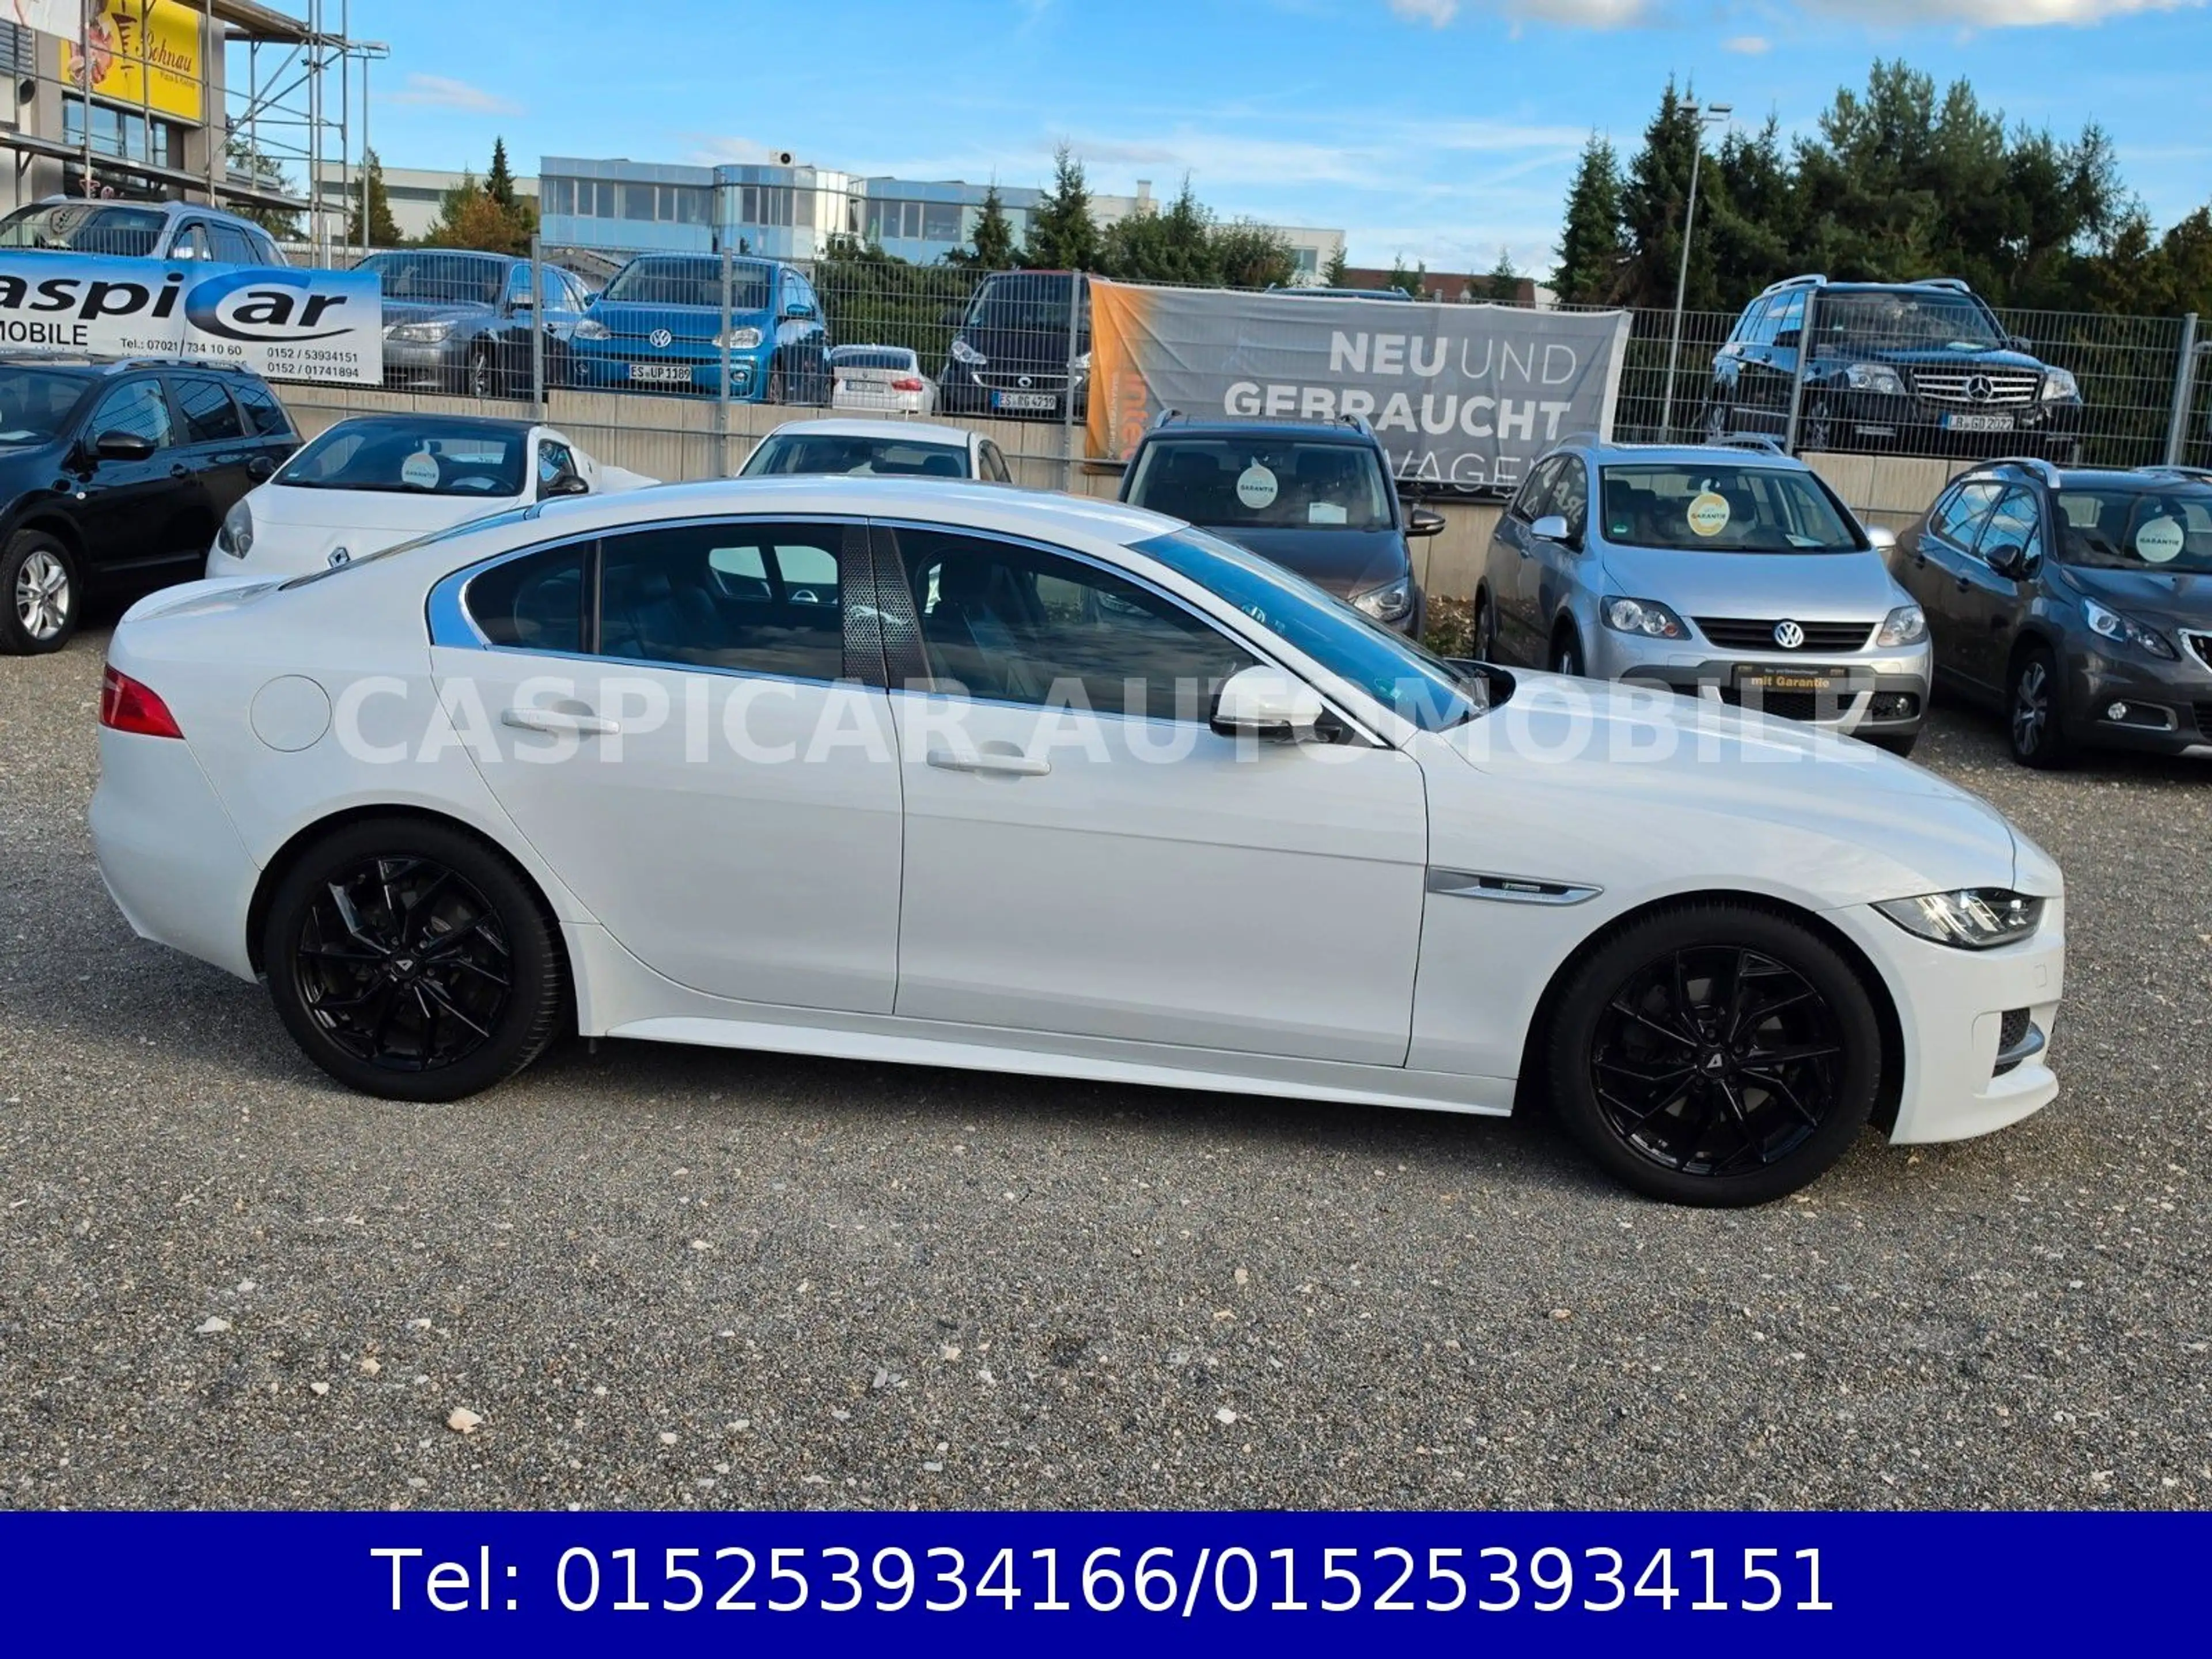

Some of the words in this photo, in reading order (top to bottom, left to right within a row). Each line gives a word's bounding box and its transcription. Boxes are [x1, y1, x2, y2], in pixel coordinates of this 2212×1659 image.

[0, 321, 88, 346] OBILE
[120, 338, 143, 349] Tel.:
[147, 340, 177, 351] 07021
[187, 342, 205, 353] 734
[212, 344, 224, 354] 10
[228, 346, 242, 355] 60
[267, 347, 294, 358] 0152
[305, 350, 358, 363] 53934151
[1330, 331, 1448, 377] NEU
[1461, 337, 1576, 385] UND
[268, 362, 294, 373] 0152
[305, 365, 359, 377] 01741894
[1224, 381, 1571, 441] GEBRAUCHT
[1384, 448, 1536, 498] AGE
[1240, 483, 1275, 493] GARANTIE
[2139, 537, 2180, 546] GARANTIE
[1751, 676, 1772, 686] mit
[1776, 676, 1831, 688] Garantie
